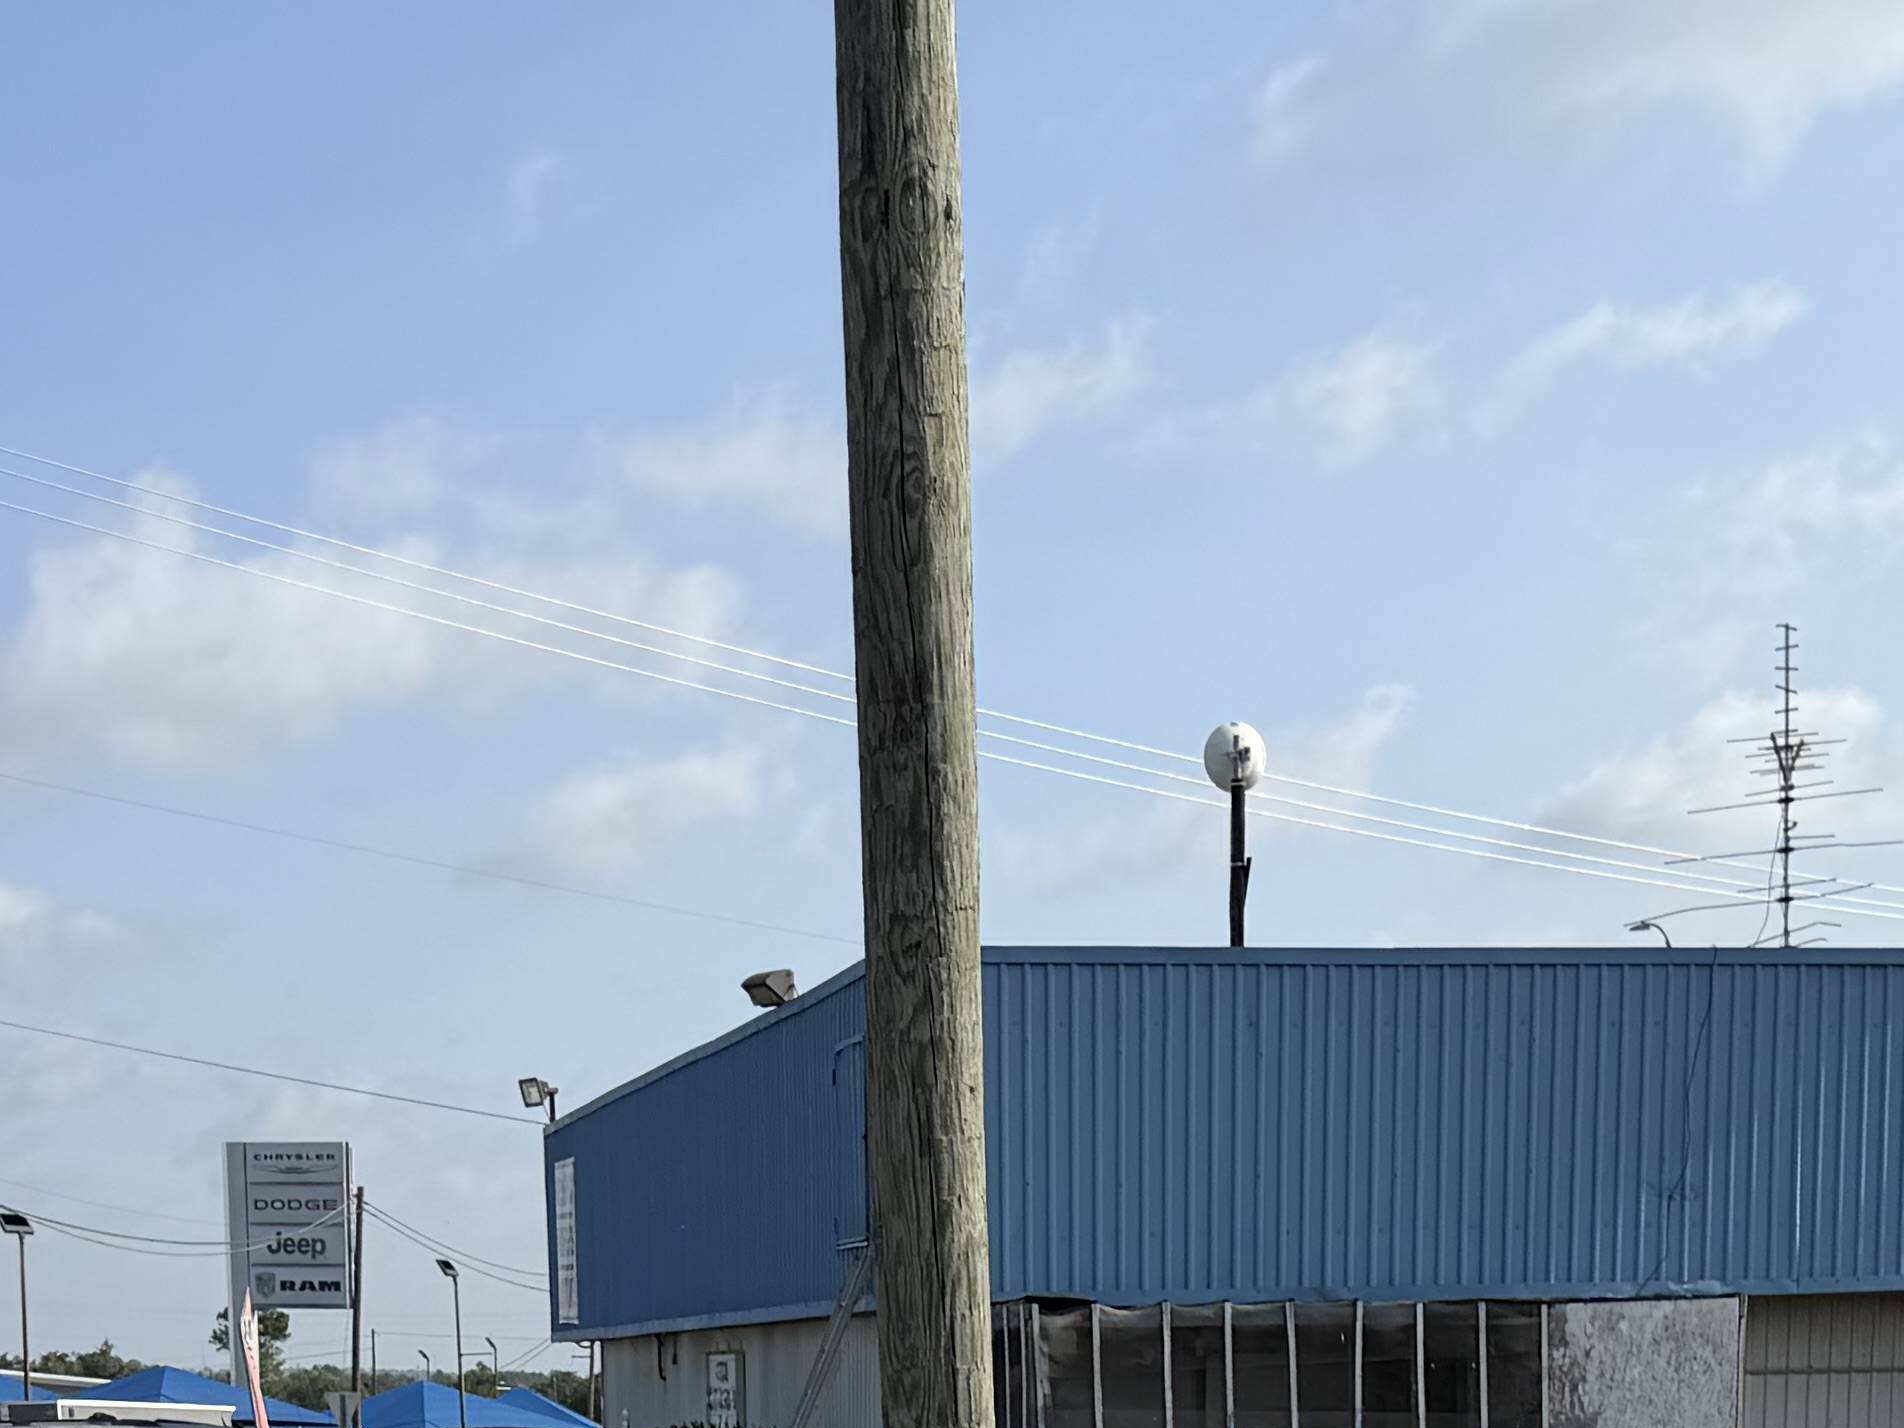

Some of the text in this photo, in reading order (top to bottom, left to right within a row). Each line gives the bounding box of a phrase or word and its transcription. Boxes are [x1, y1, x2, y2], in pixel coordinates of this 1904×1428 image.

[253, 1153, 335, 1162] CHRYSLER
[254, 1199, 338, 1211] DODGE
[267, 1231, 326, 1260] Jeep
[280, 1280, 342, 1292] RAM
